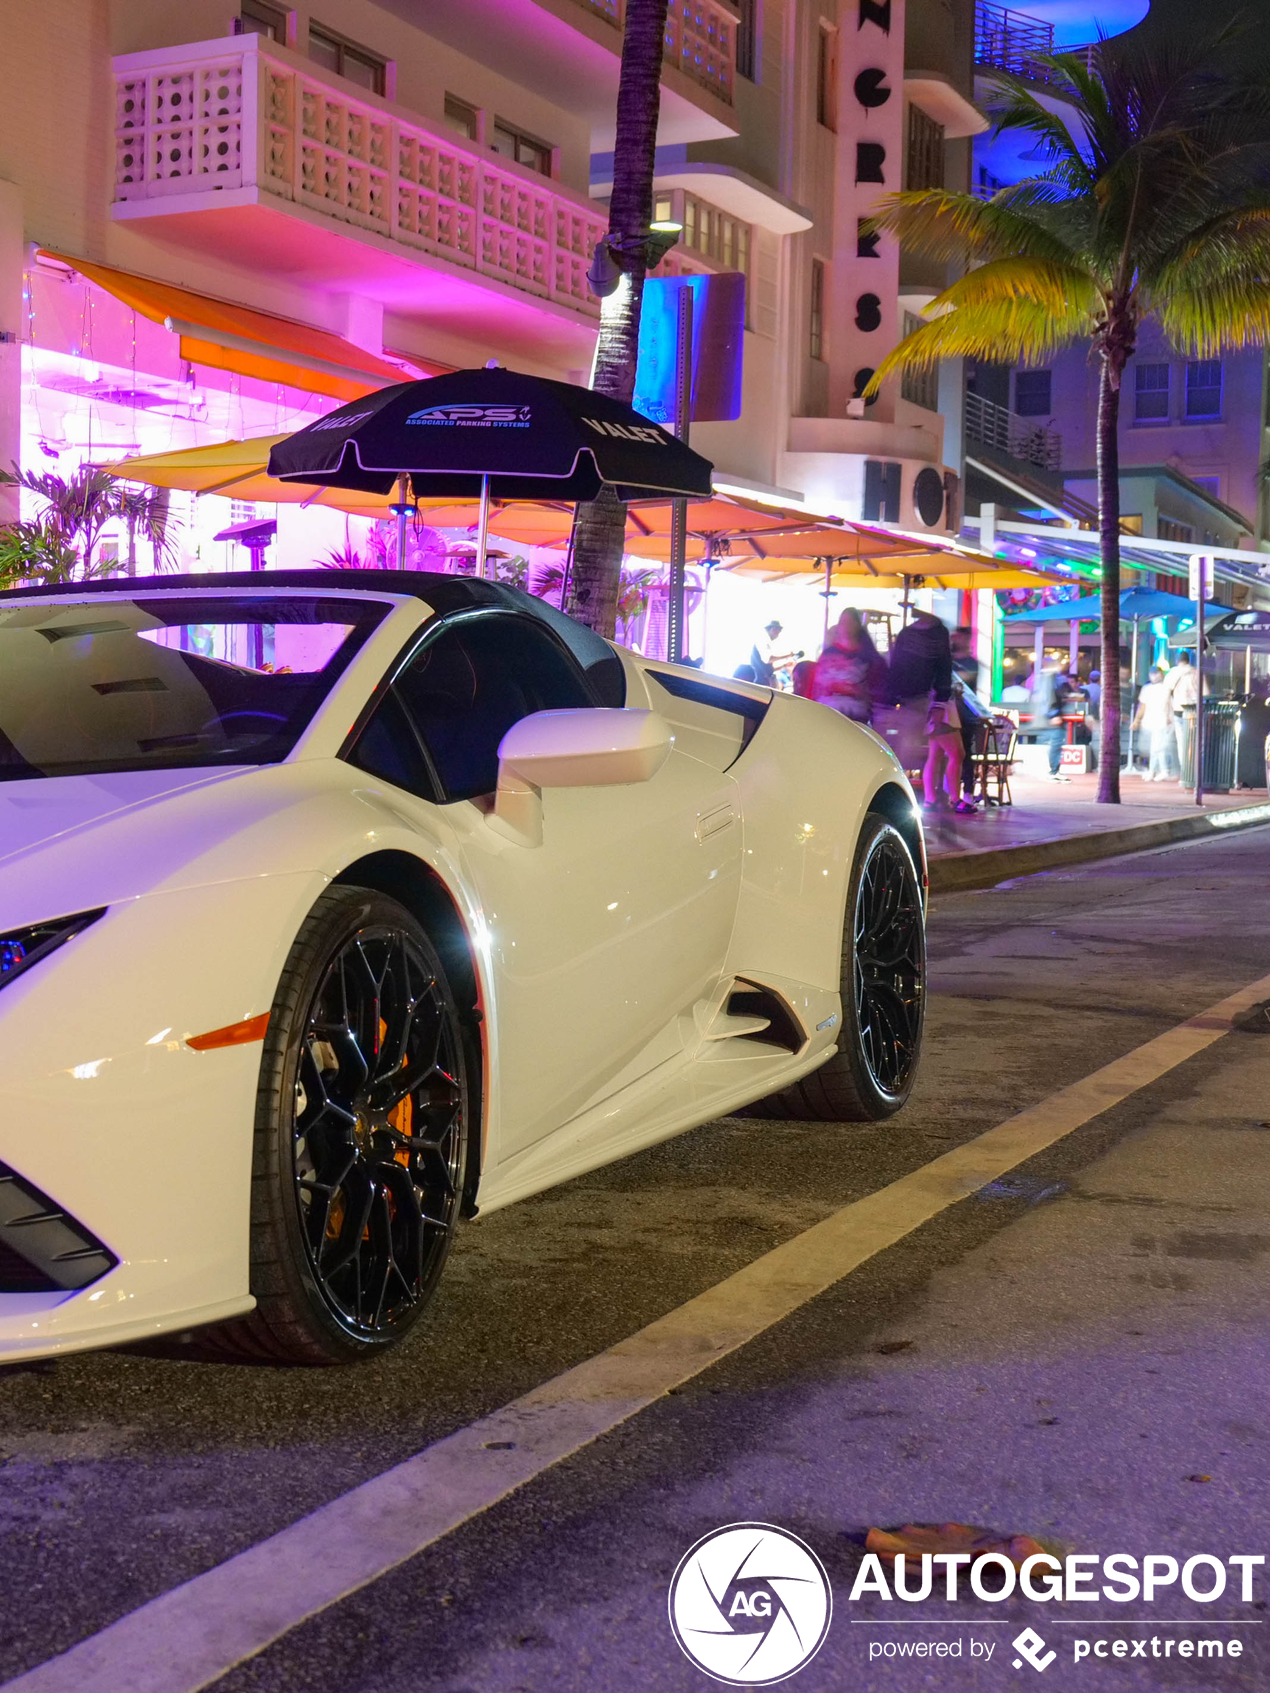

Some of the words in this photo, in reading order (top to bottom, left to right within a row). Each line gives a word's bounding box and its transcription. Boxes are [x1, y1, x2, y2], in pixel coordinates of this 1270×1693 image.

[310, 410, 374, 432] VALET
[420, 408, 517, 421] APS
[581, 416, 668, 445] VALET
[1223, 623, 1270, 631] VALET
